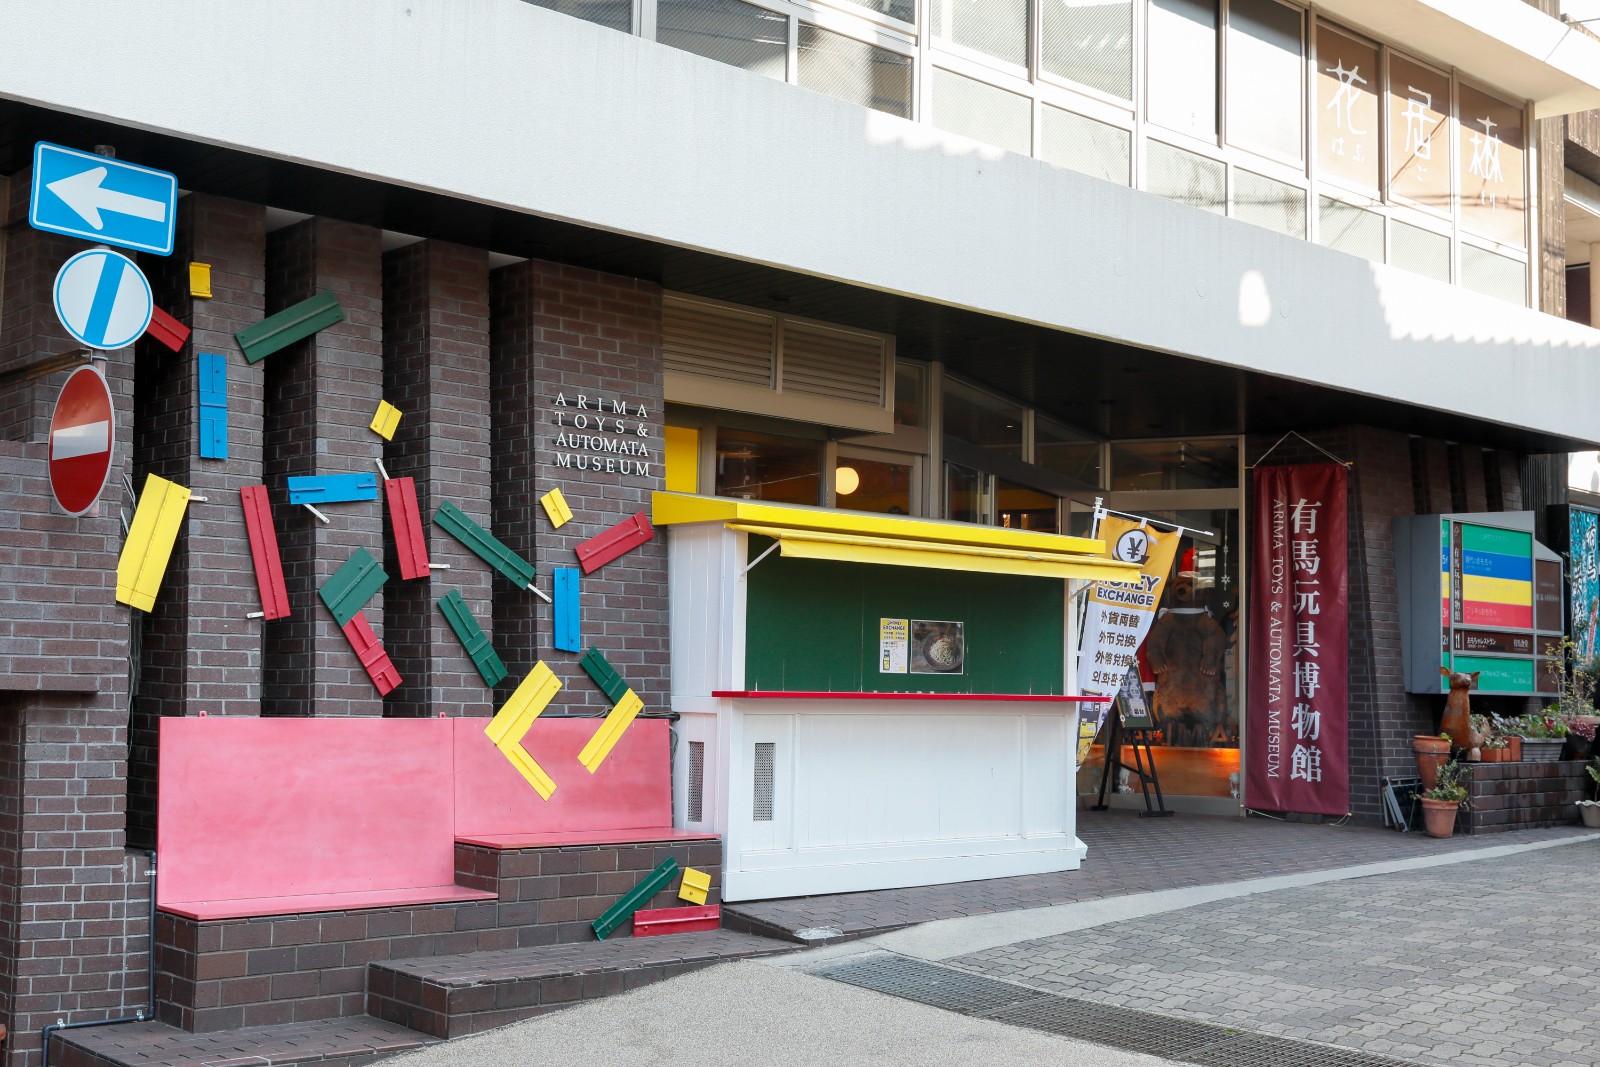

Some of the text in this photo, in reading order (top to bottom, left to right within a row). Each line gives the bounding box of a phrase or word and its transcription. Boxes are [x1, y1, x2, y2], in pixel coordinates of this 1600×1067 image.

[554, 392, 648, 418] ARIMA
[554, 411, 648, 437] TOYS &
[556, 432, 649, 457] AUTOMATA
[556, 453, 650, 477] MUSEUM
[1097, 586, 1154, 606] EXCHANGE
[1101, 609, 1140, 629] 外貨両替
[1267, 499, 1285, 778] ARIMA TOYS & AUTOMATA MUSEUM
[1289, 498, 1322, 783] 有馬玩具博物館
